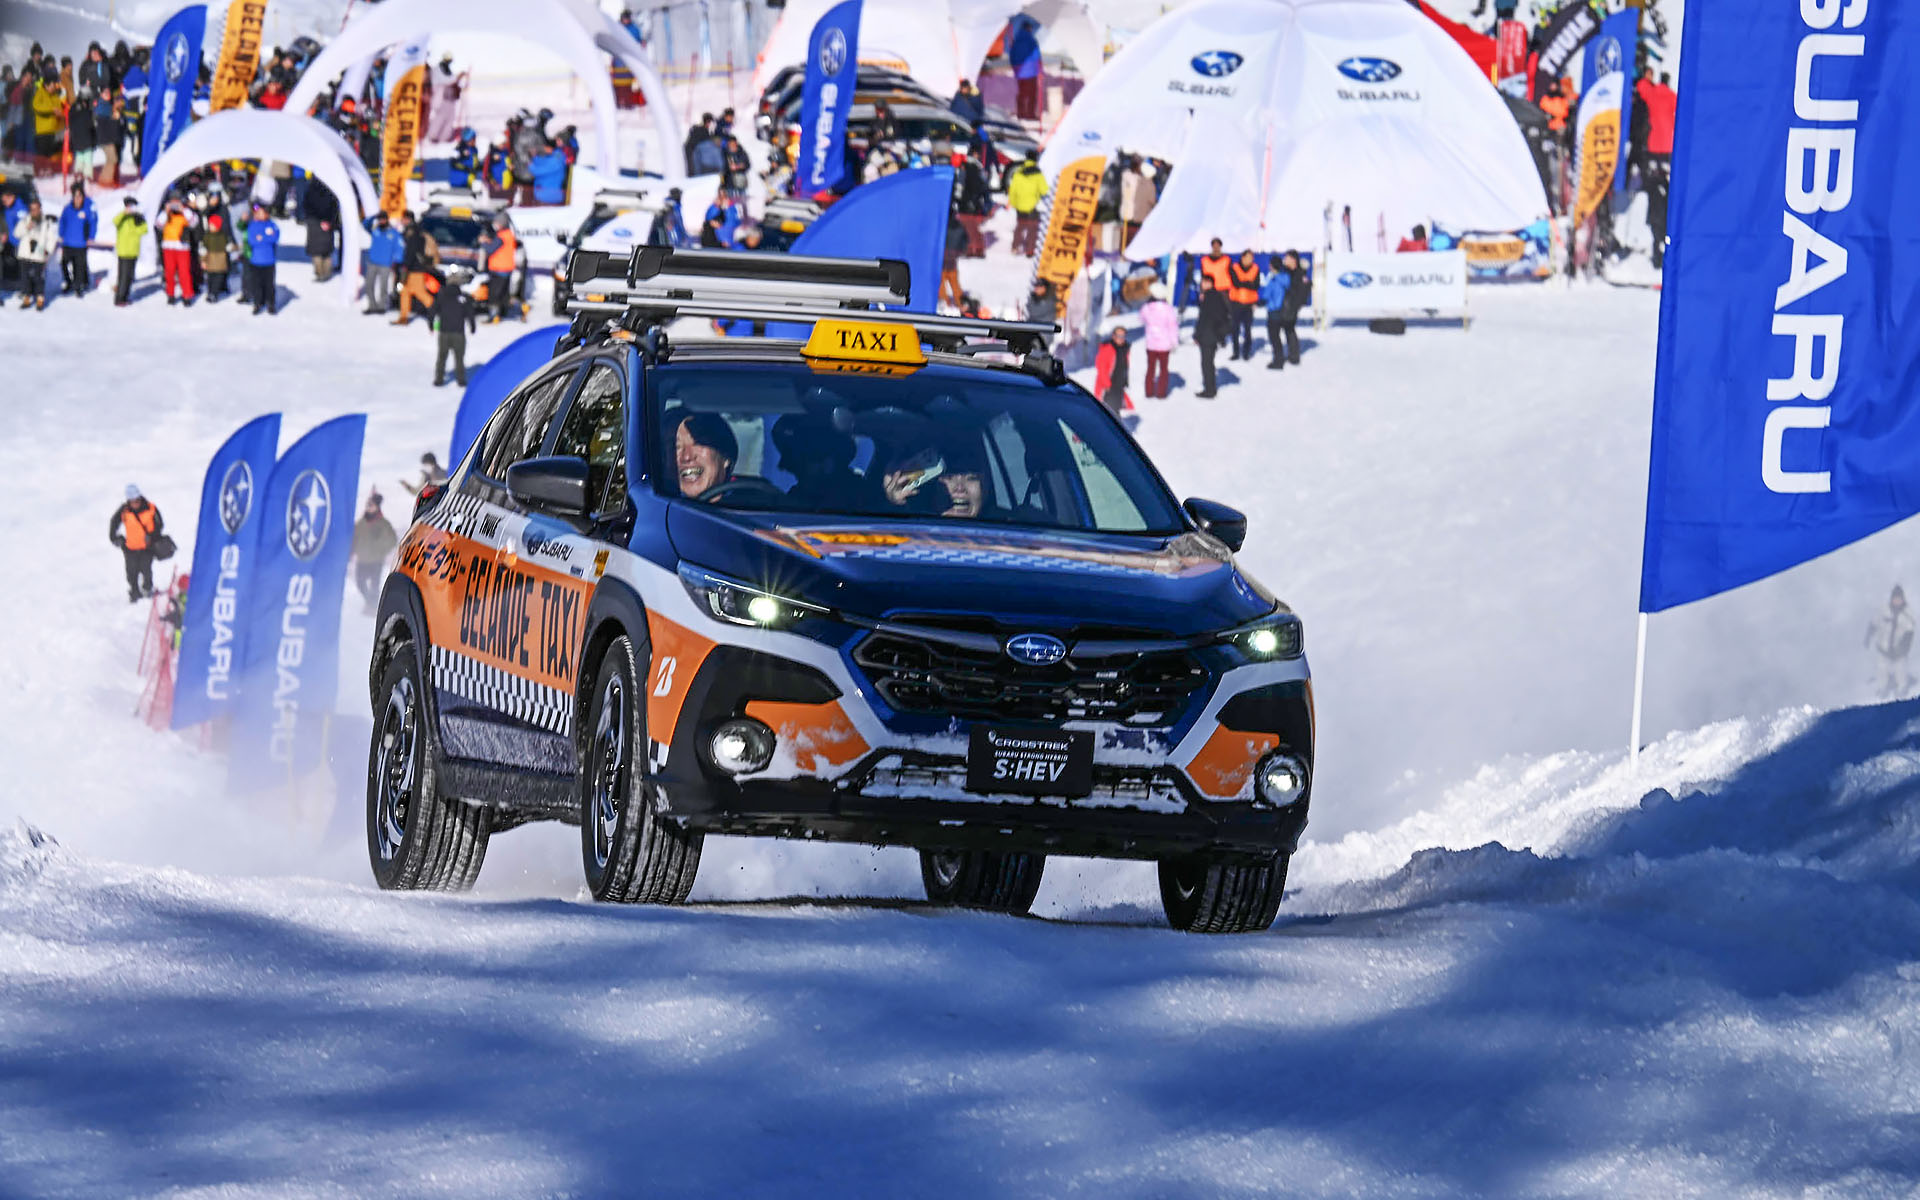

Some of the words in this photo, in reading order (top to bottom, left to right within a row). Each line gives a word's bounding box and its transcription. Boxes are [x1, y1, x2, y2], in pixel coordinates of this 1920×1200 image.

[1538, 6, 1595, 76] THULE
[1337, 88, 1421, 102] SUBARU
[1055, 168, 1098, 260] GELANDE
[1378, 273, 1454, 286] SUBARU
[836, 328, 898, 352] TAXI
[540, 541, 574, 562] SUBARU
[206, 544, 239, 700] SUBARU
[460, 555, 536, 669] GELANDE
[541, 580, 581, 684] TAXI
[270, 573, 313, 763] SUBARU
[995, 738, 1068, 750] CROSSTREK
[995, 750, 1019, 759] SUBARU
[1020, 751, 1044, 760] STRONG
[993, 758, 1067, 782] S:HEV
